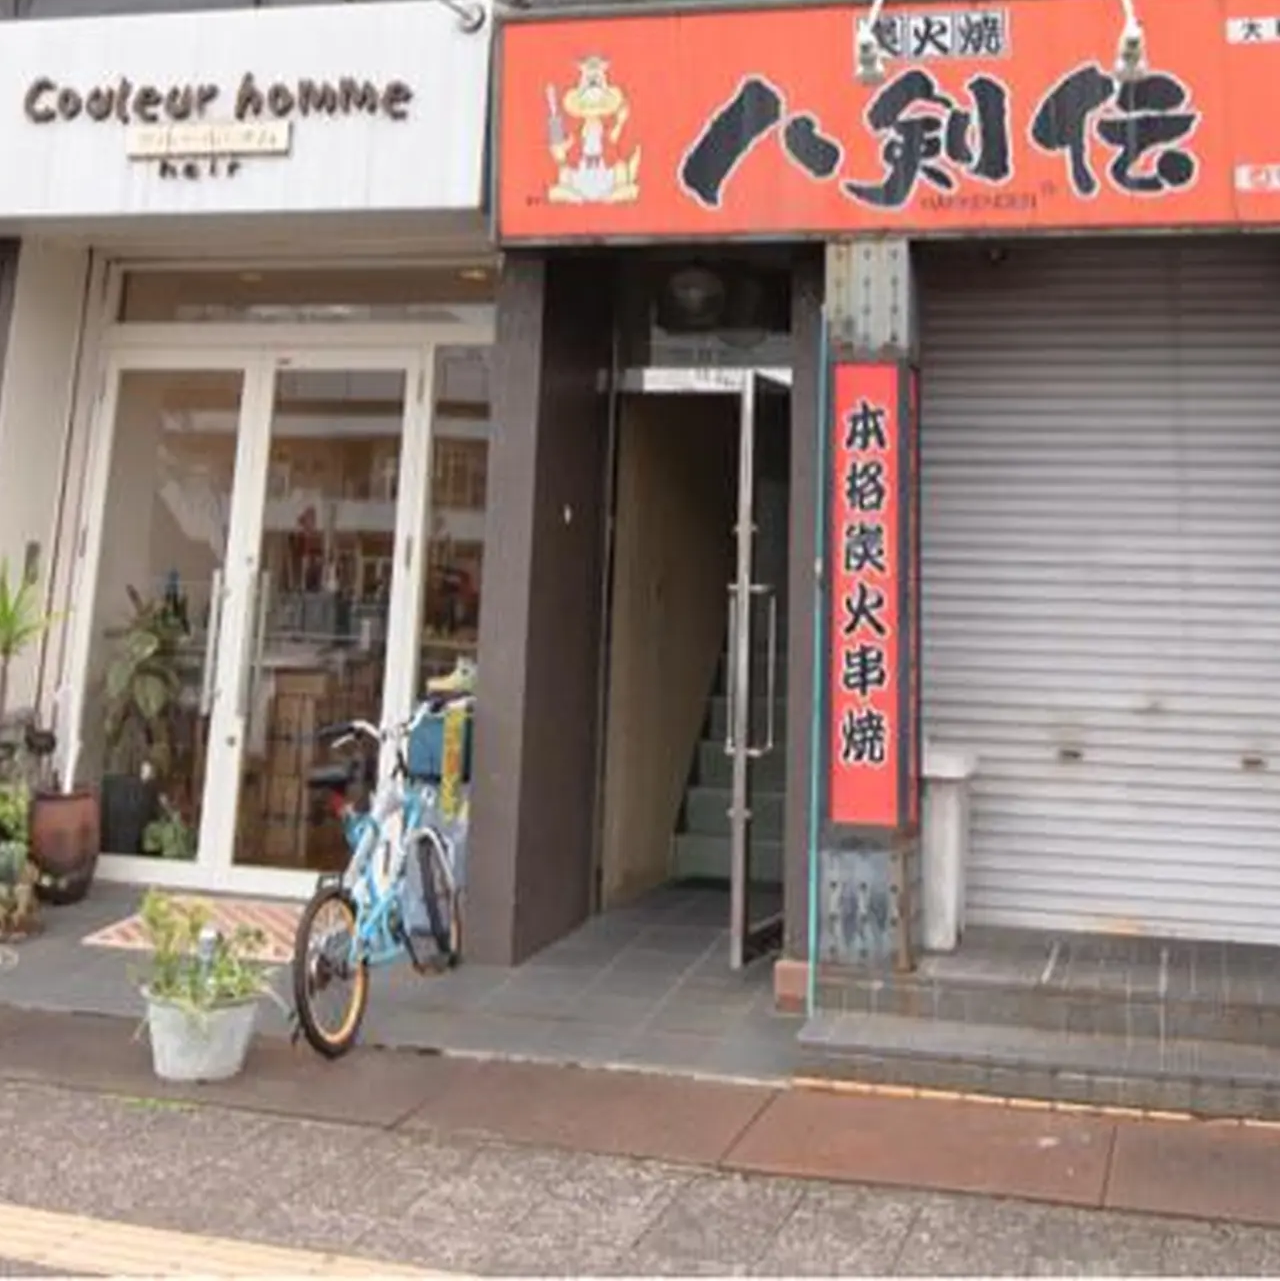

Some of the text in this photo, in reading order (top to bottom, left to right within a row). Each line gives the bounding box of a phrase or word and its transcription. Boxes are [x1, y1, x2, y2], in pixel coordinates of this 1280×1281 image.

[23, 70, 414, 125] Couleur homme
[677, 66, 1202, 212] 八剣伝
[158, 157, 243, 181] hair
[842, 399, 888, 767] 本格炭火串焼
